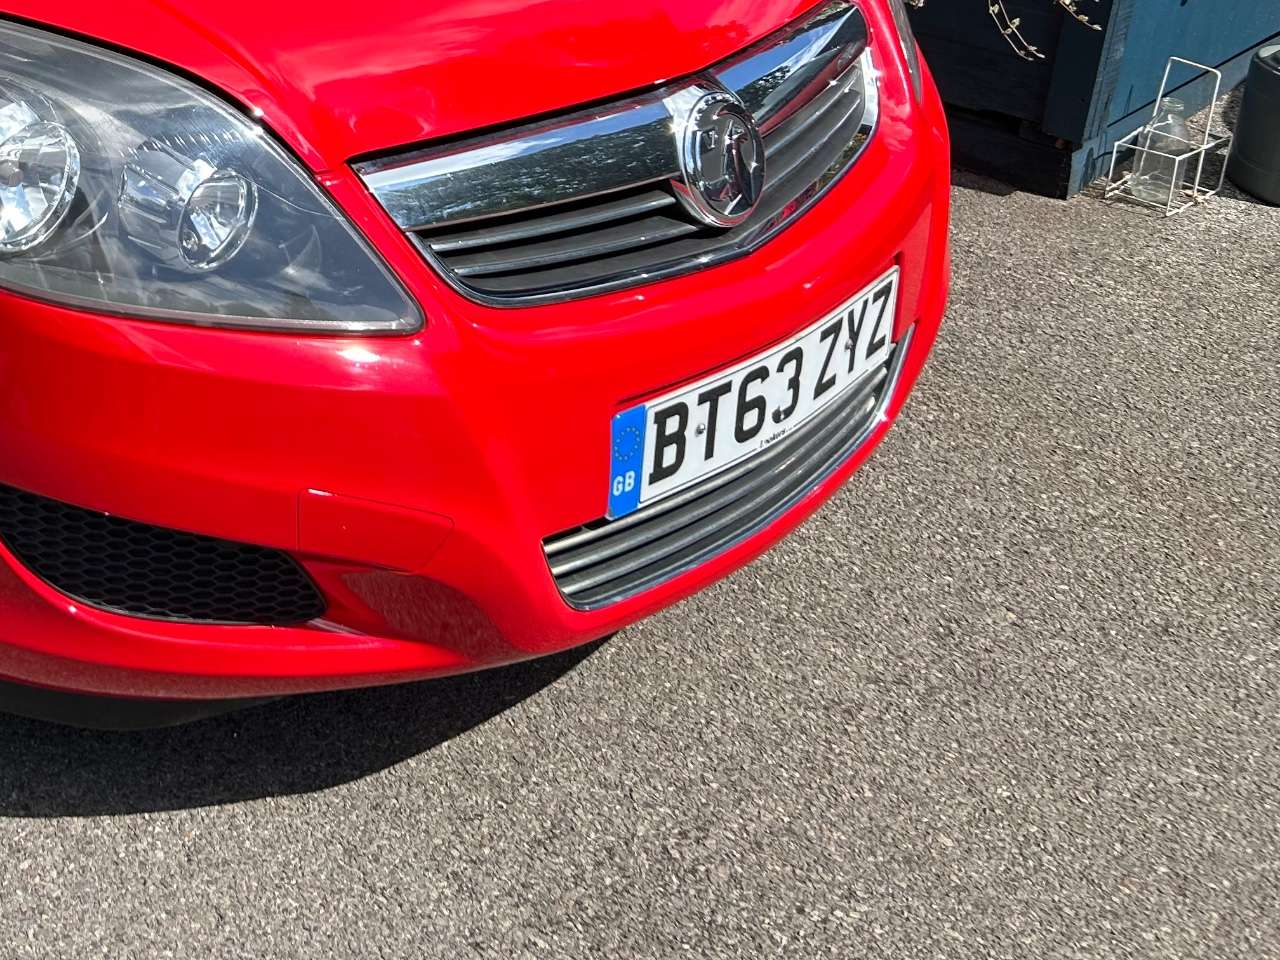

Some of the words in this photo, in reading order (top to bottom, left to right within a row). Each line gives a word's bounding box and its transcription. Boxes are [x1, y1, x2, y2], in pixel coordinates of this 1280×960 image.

[637, 346, 805, 486] BT63
[812, 279, 894, 401] ZYZ
[612, 470, 636, 496] GB
